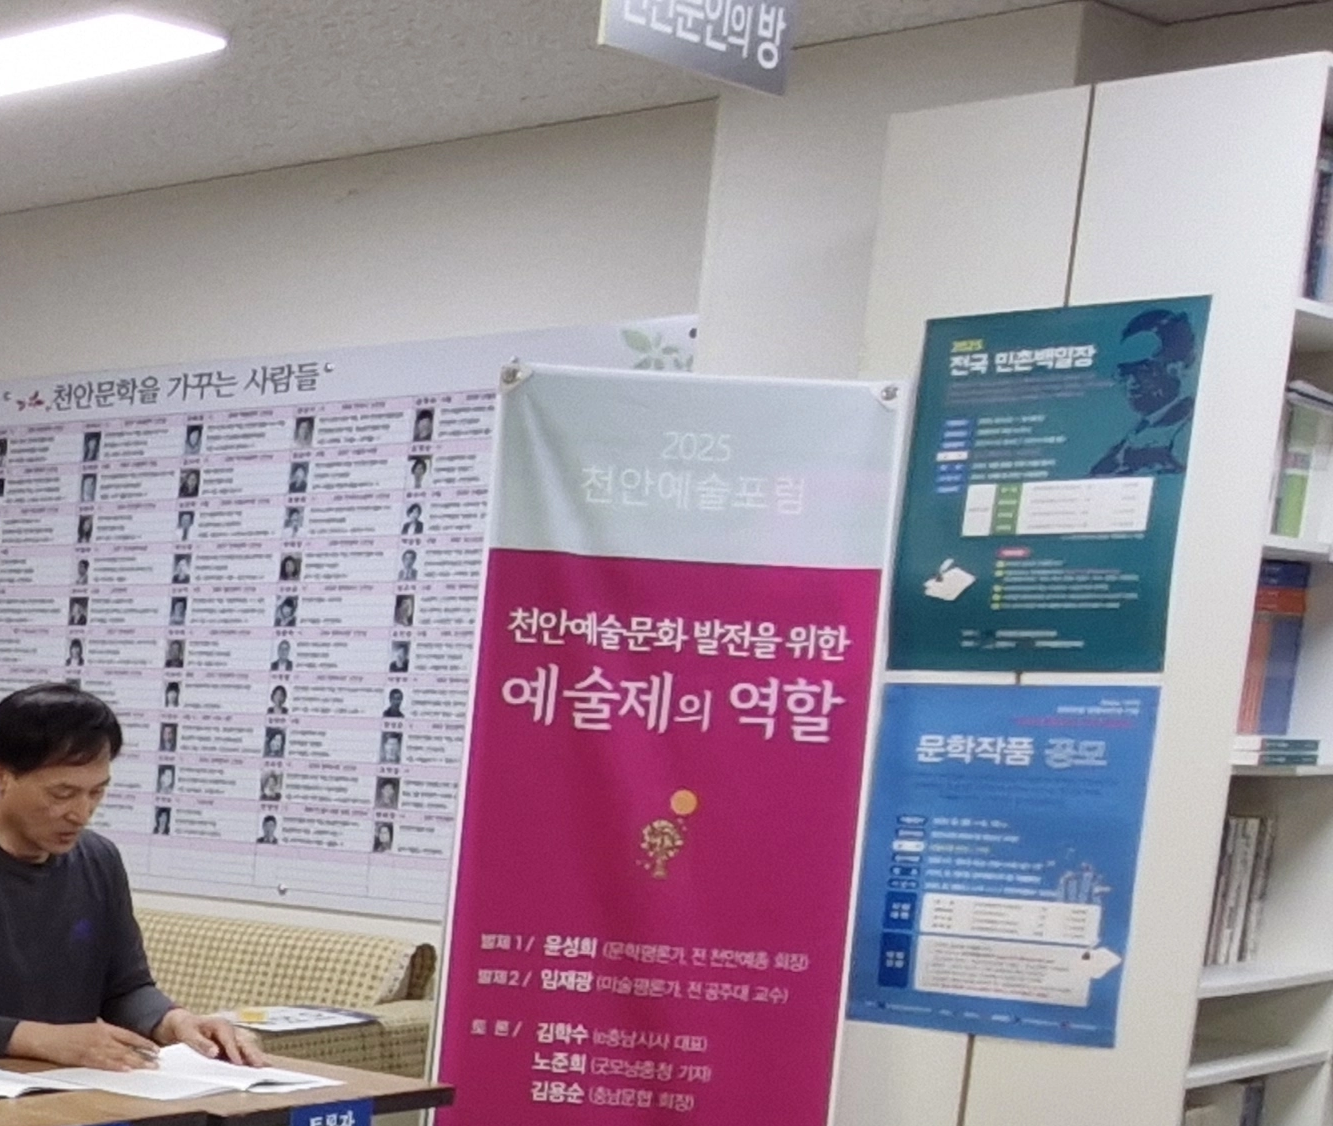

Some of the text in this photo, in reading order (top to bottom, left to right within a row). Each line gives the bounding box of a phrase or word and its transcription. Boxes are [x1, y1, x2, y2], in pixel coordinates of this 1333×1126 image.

[757, 3, 786, 69] 방
[51, 361, 321, 414] 천안문학을 가꾸는 사람들
[661, 431, 731, 462] 2025
[580, 465, 806, 515] 천안예술포럼
[508, 607, 852, 662] 천안예술문화 발전을 위한
[502, 662, 846, 743] 예술제의 역할
[536, 1023, 589, 1045] 김학수
[532, 1052, 587, 1076] 노준희
[530, 1081, 585, 1105] 김용순
